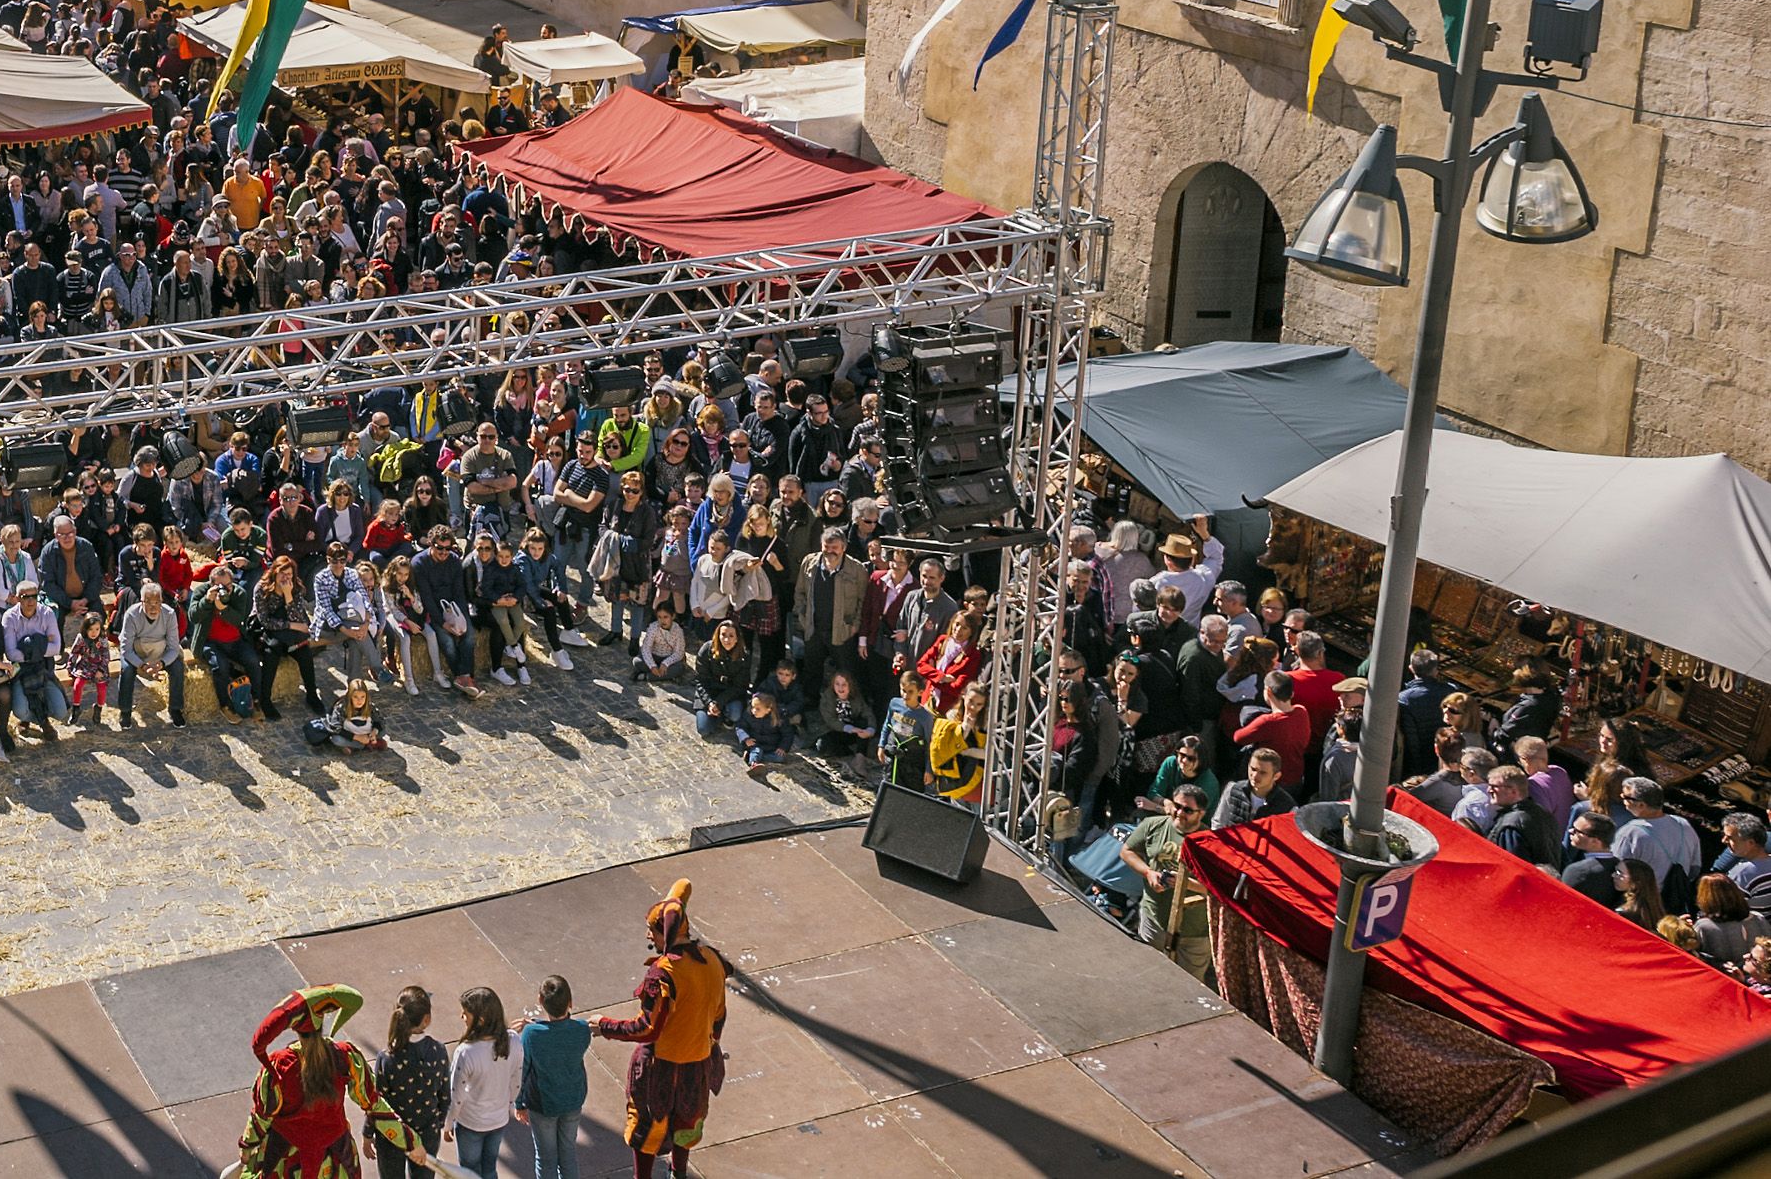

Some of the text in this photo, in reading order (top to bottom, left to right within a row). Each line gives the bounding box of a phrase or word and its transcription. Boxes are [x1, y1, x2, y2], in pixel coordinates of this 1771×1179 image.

[280, 64, 403, 85] Chocolate Artesano COMES
[1364, 884, 1398, 937] P
